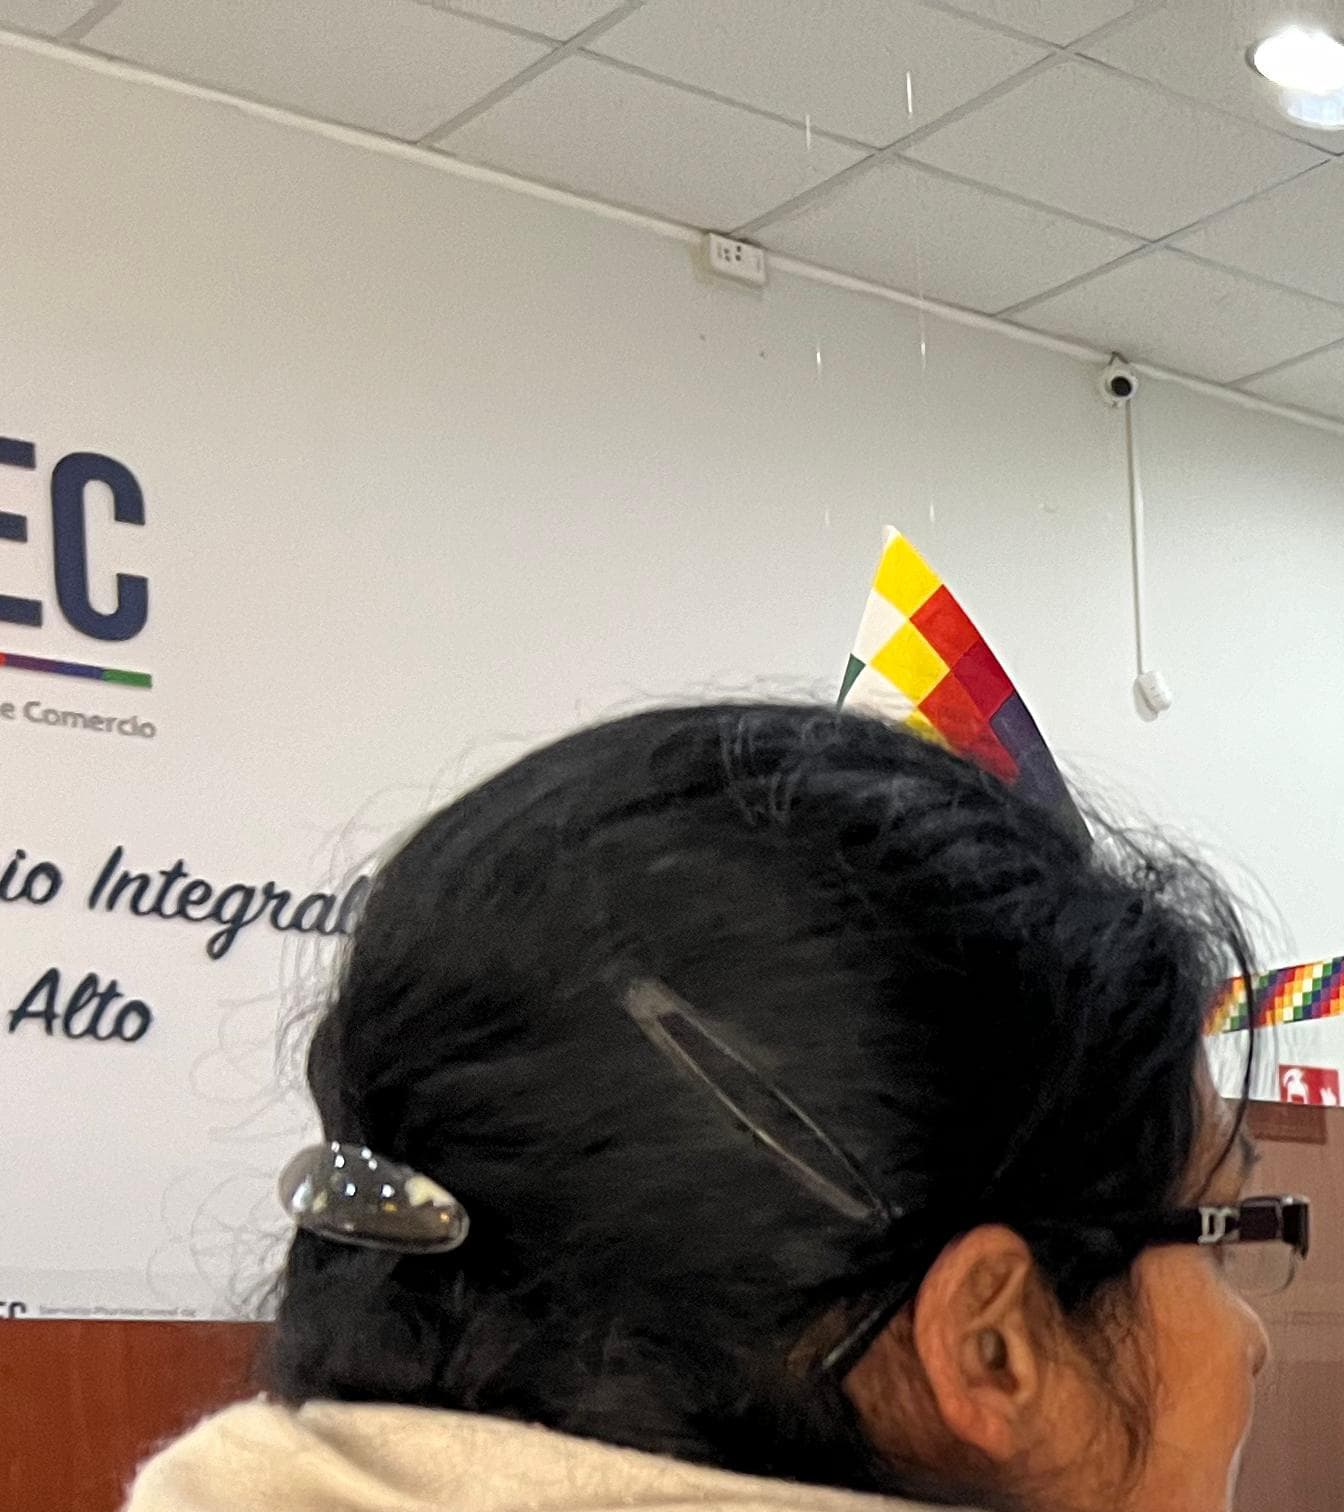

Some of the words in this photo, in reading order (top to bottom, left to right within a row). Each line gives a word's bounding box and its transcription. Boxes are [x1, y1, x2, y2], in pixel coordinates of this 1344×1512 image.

[23, 701, 156, 738] Comercio
[87, 845, 372, 961] Integral
[8, 967, 152, 1043] Alto
